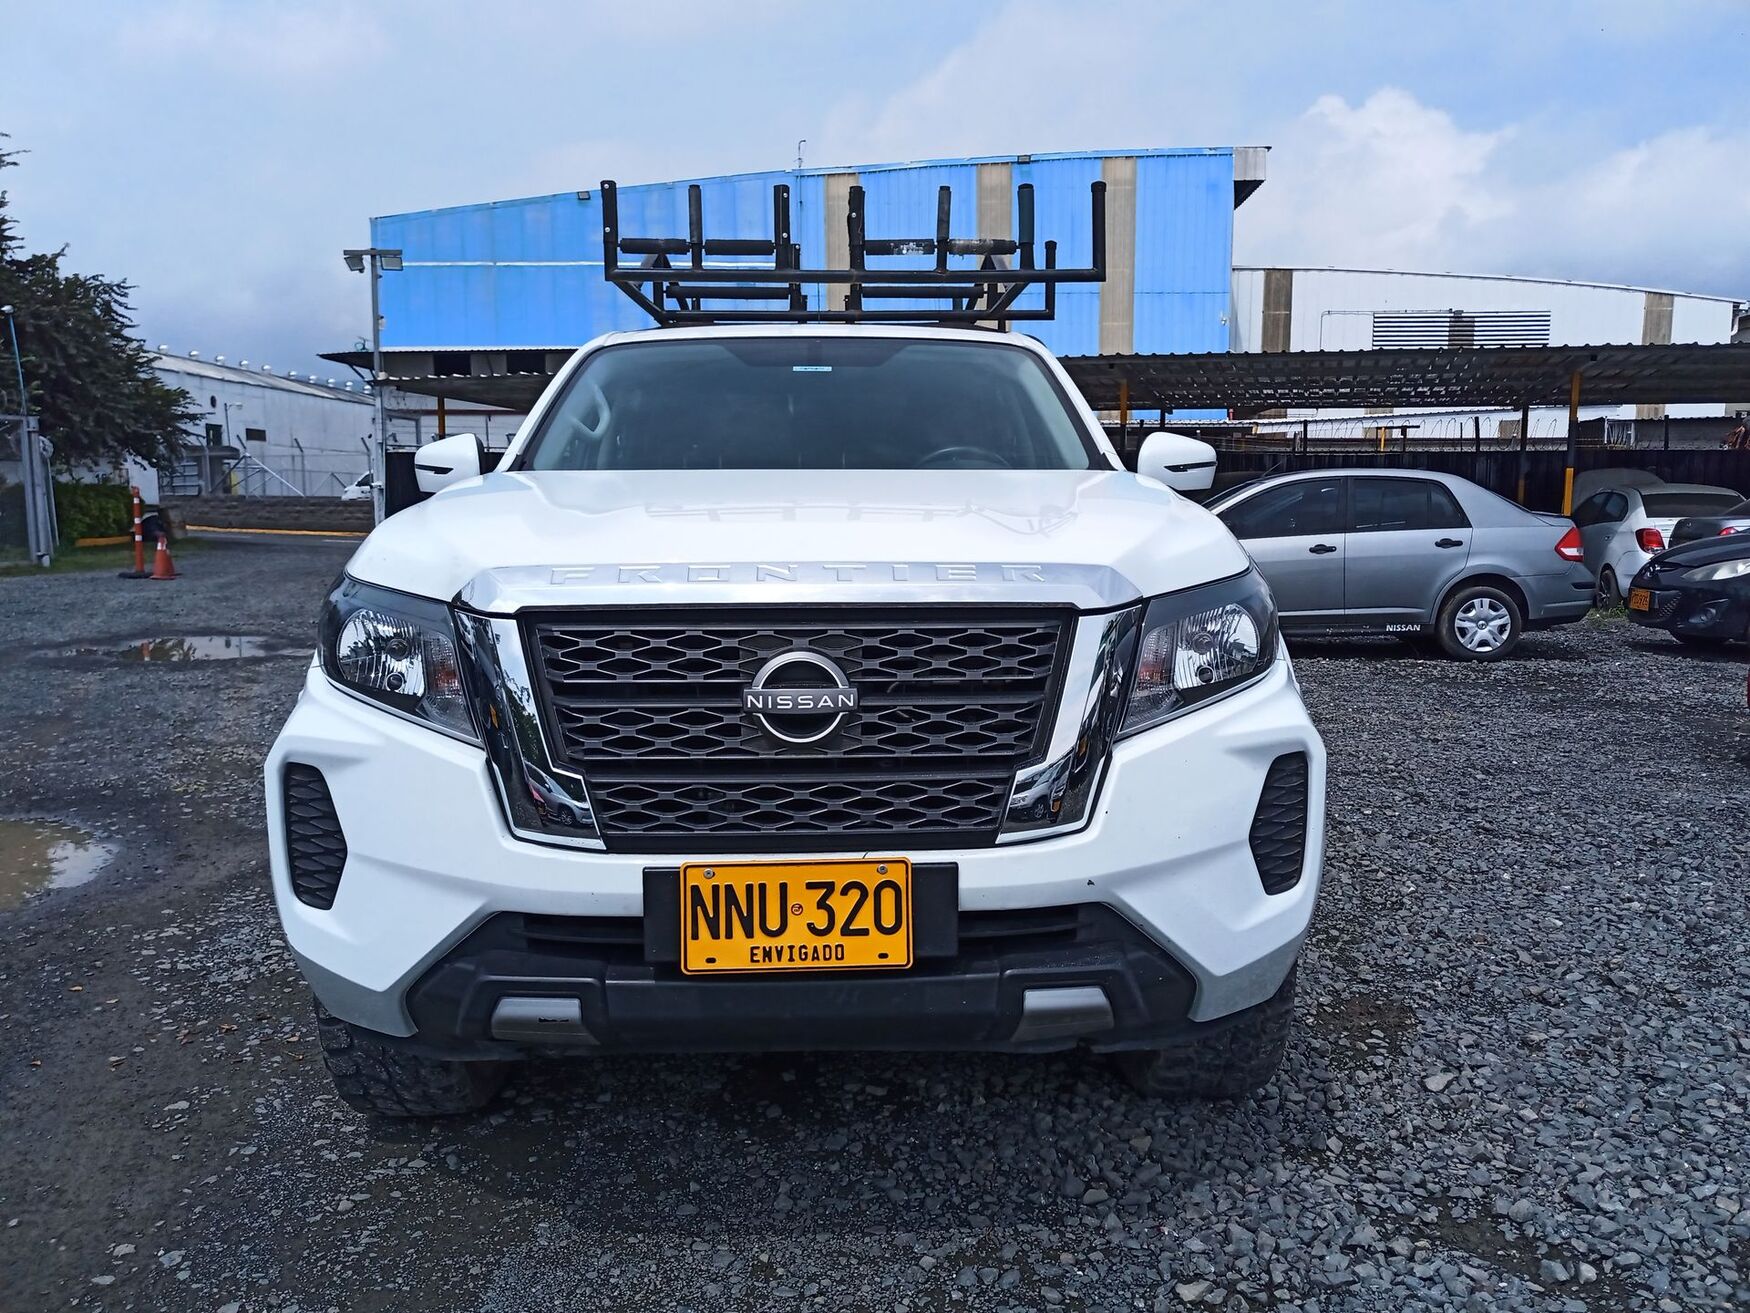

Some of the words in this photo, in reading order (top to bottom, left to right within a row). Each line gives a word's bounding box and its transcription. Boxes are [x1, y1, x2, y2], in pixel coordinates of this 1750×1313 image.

[550, 564, 1045, 585] FRONTIER
[1386, 624, 1421, 632] NISSAN
[747, 694, 854, 709] NISSAN
[690, 881, 788, 941] NNU
[805, 879, 903, 937] 320
[750, 943, 845, 963] ENVIGADO
